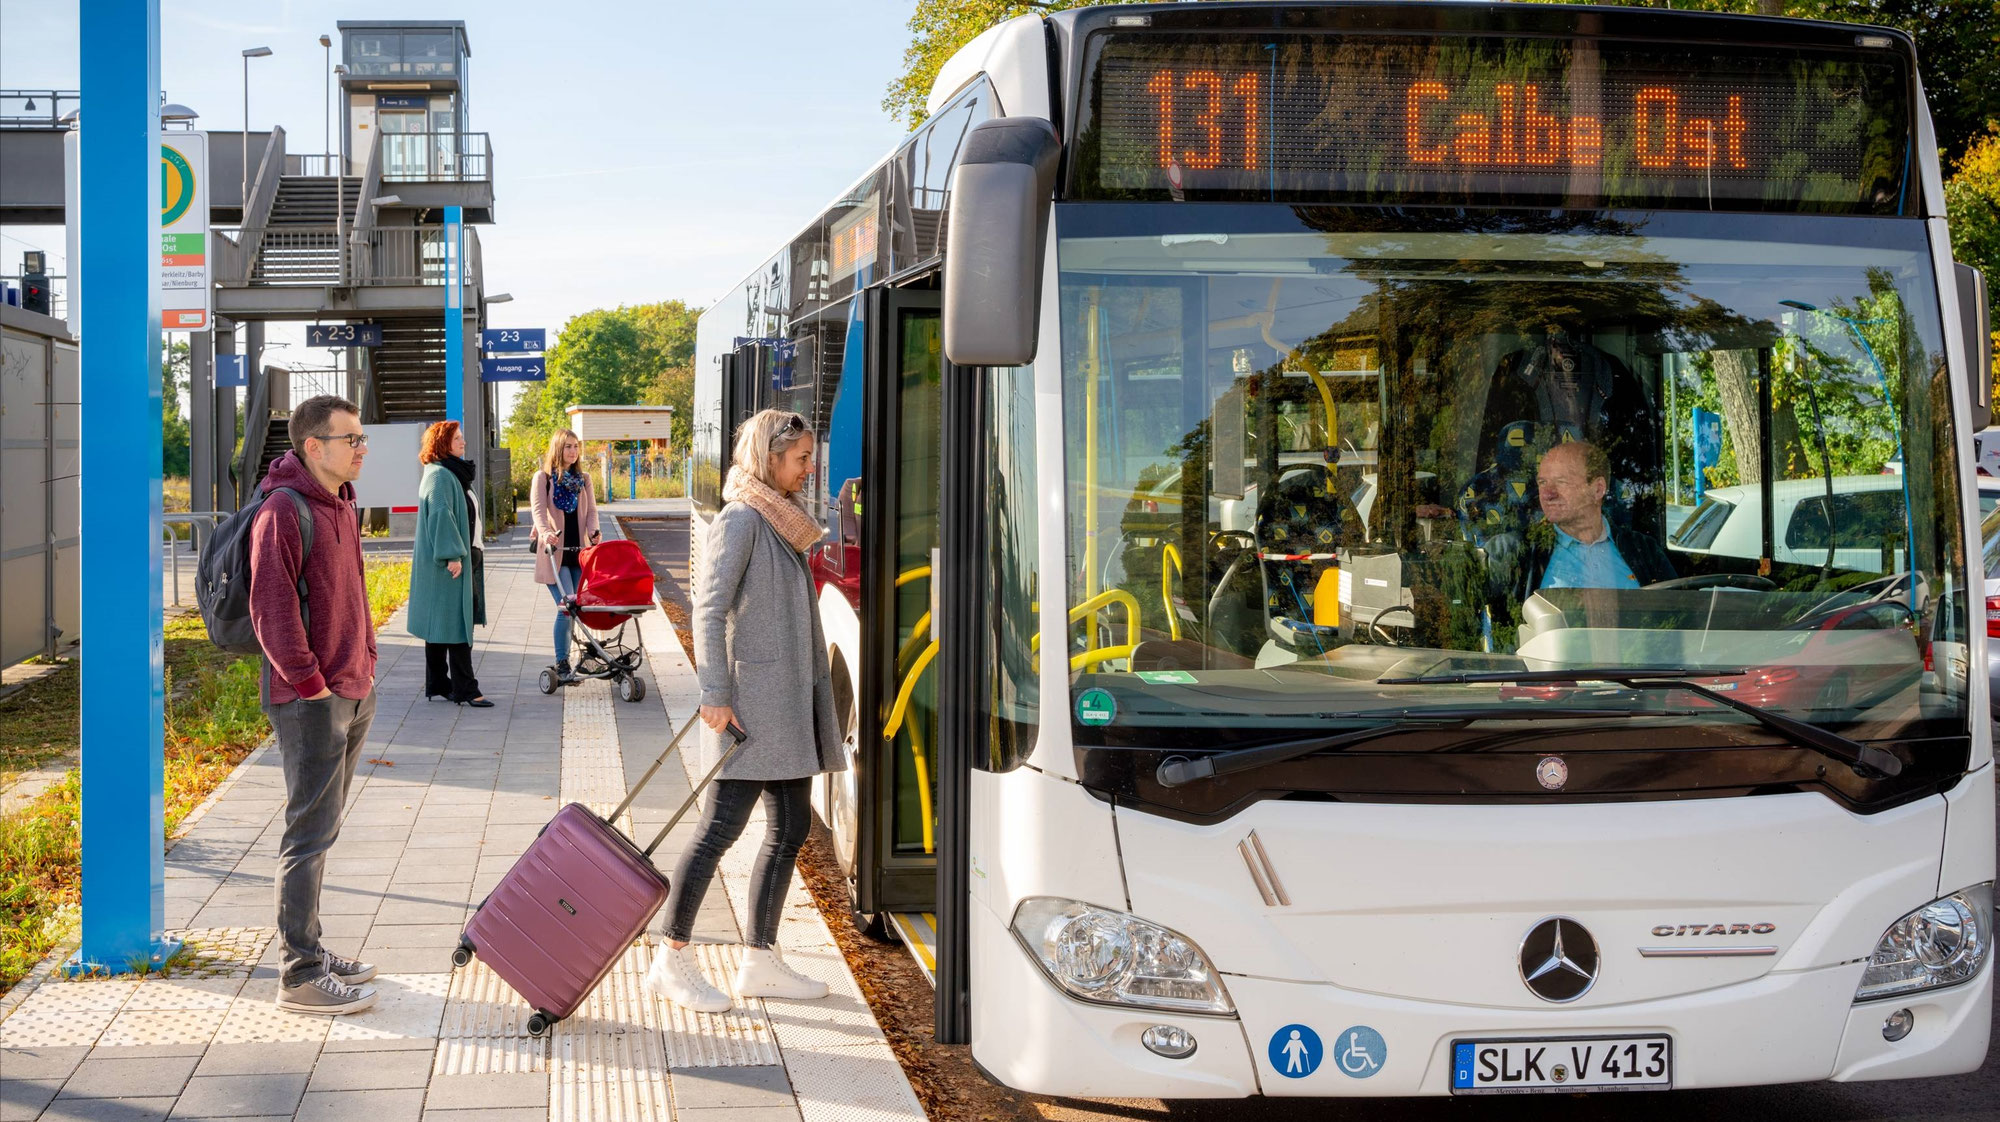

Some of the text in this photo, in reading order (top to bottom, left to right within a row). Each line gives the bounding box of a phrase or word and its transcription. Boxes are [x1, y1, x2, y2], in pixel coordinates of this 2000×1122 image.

[1147, 69, 1746, 170] 131 Calbe Ost
[328, 325, 356, 341] 2-3
[500, 330, 520, 342] 2-3
[233, 355, 244, 380] 1
[496, 365, 523, 373] Ausgang
[1091, 693, 1102, 710] 4
[1651, 922, 1777, 937] CITARO
[1477, 1042, 1666, 1083] SLK V 413
[1459, 1069, 1468, 1081] D
